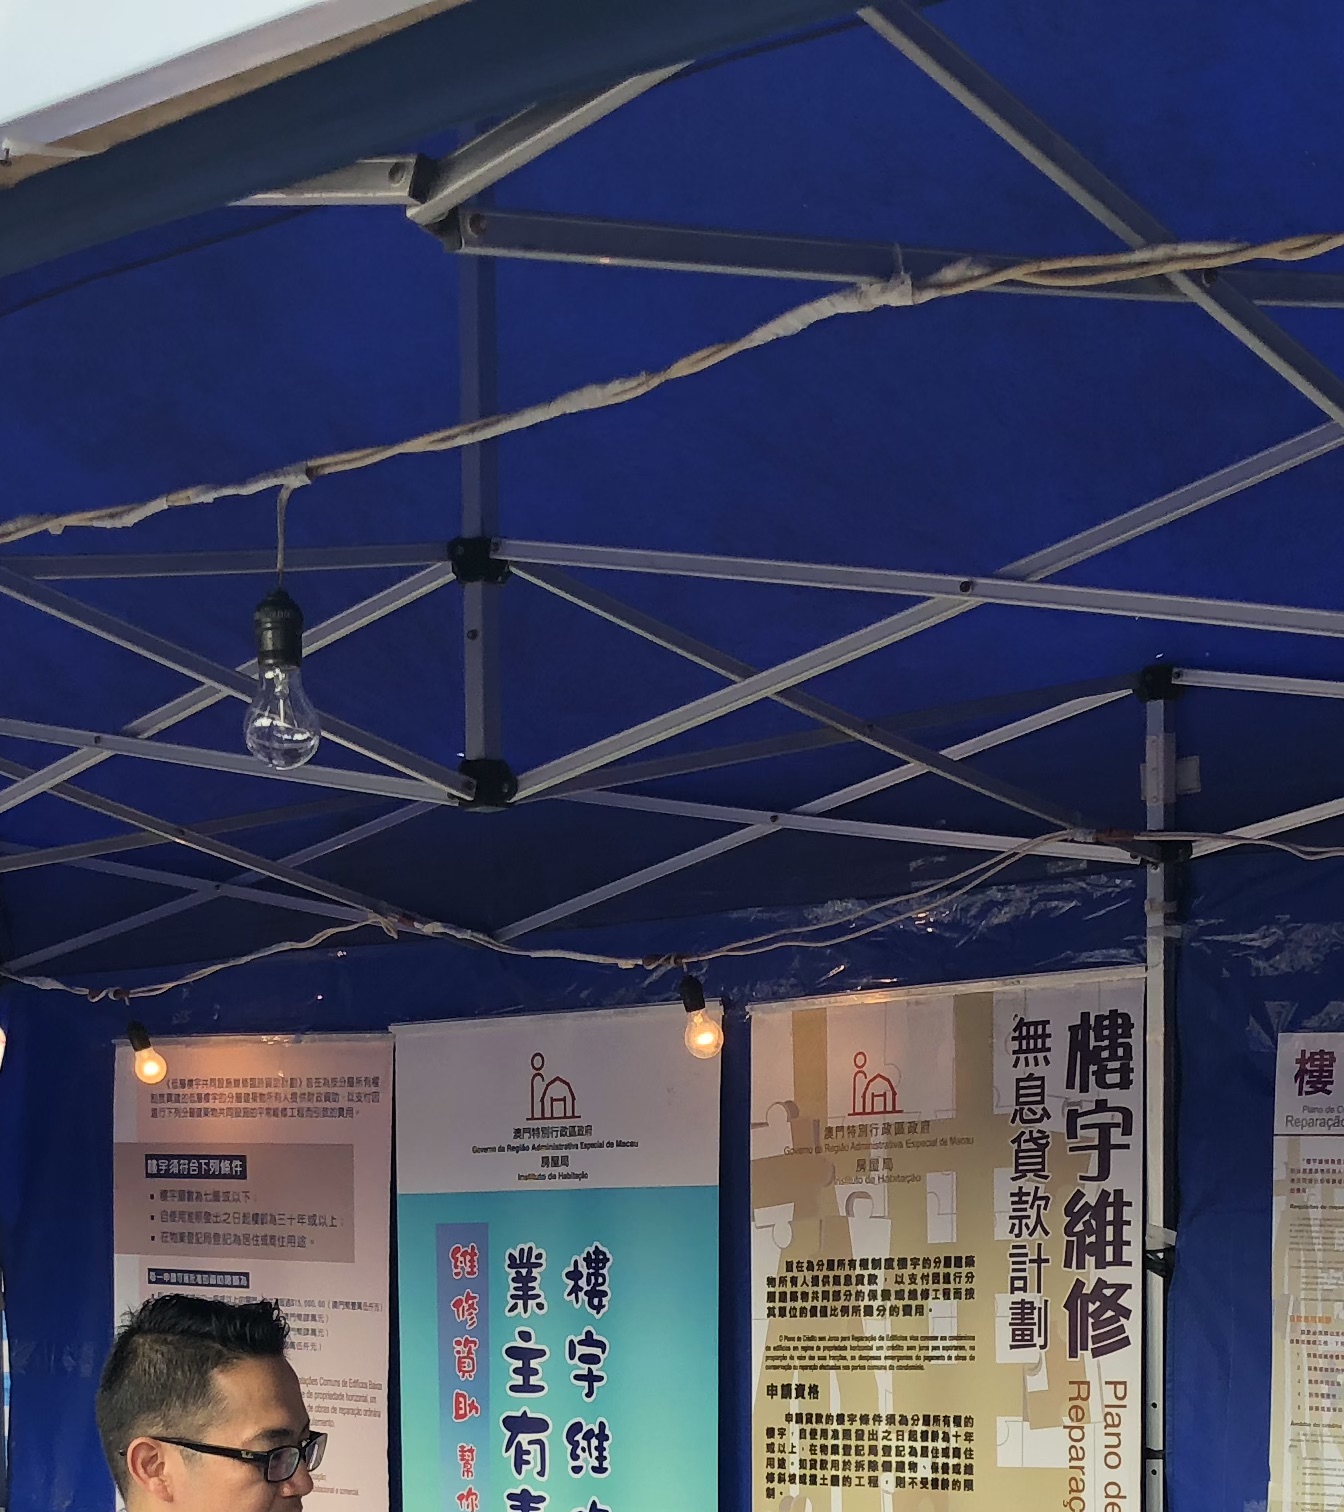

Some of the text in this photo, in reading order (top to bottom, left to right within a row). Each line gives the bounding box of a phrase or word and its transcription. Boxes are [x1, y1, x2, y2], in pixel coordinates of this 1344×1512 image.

[513, 1125, 592, 1139] 澳門特別行政區政府
[824, 1121, 931, 1140] 澳門特別行政區政府
[147, 1159, 244, 1176] 樓宇須符合下列條件
[856, 1158, 894, 1172] 房屋局
[1009, 1014, 1052, 1352] 無息貸款計劃
[1062, 1009, 1135, 1361] 樓宇維修
[450, 1245, 480, 1421] 維修資助
[766, 1383, 819, 1400] 申請資格
[1103, 1380, 1128, 1469] Plano
